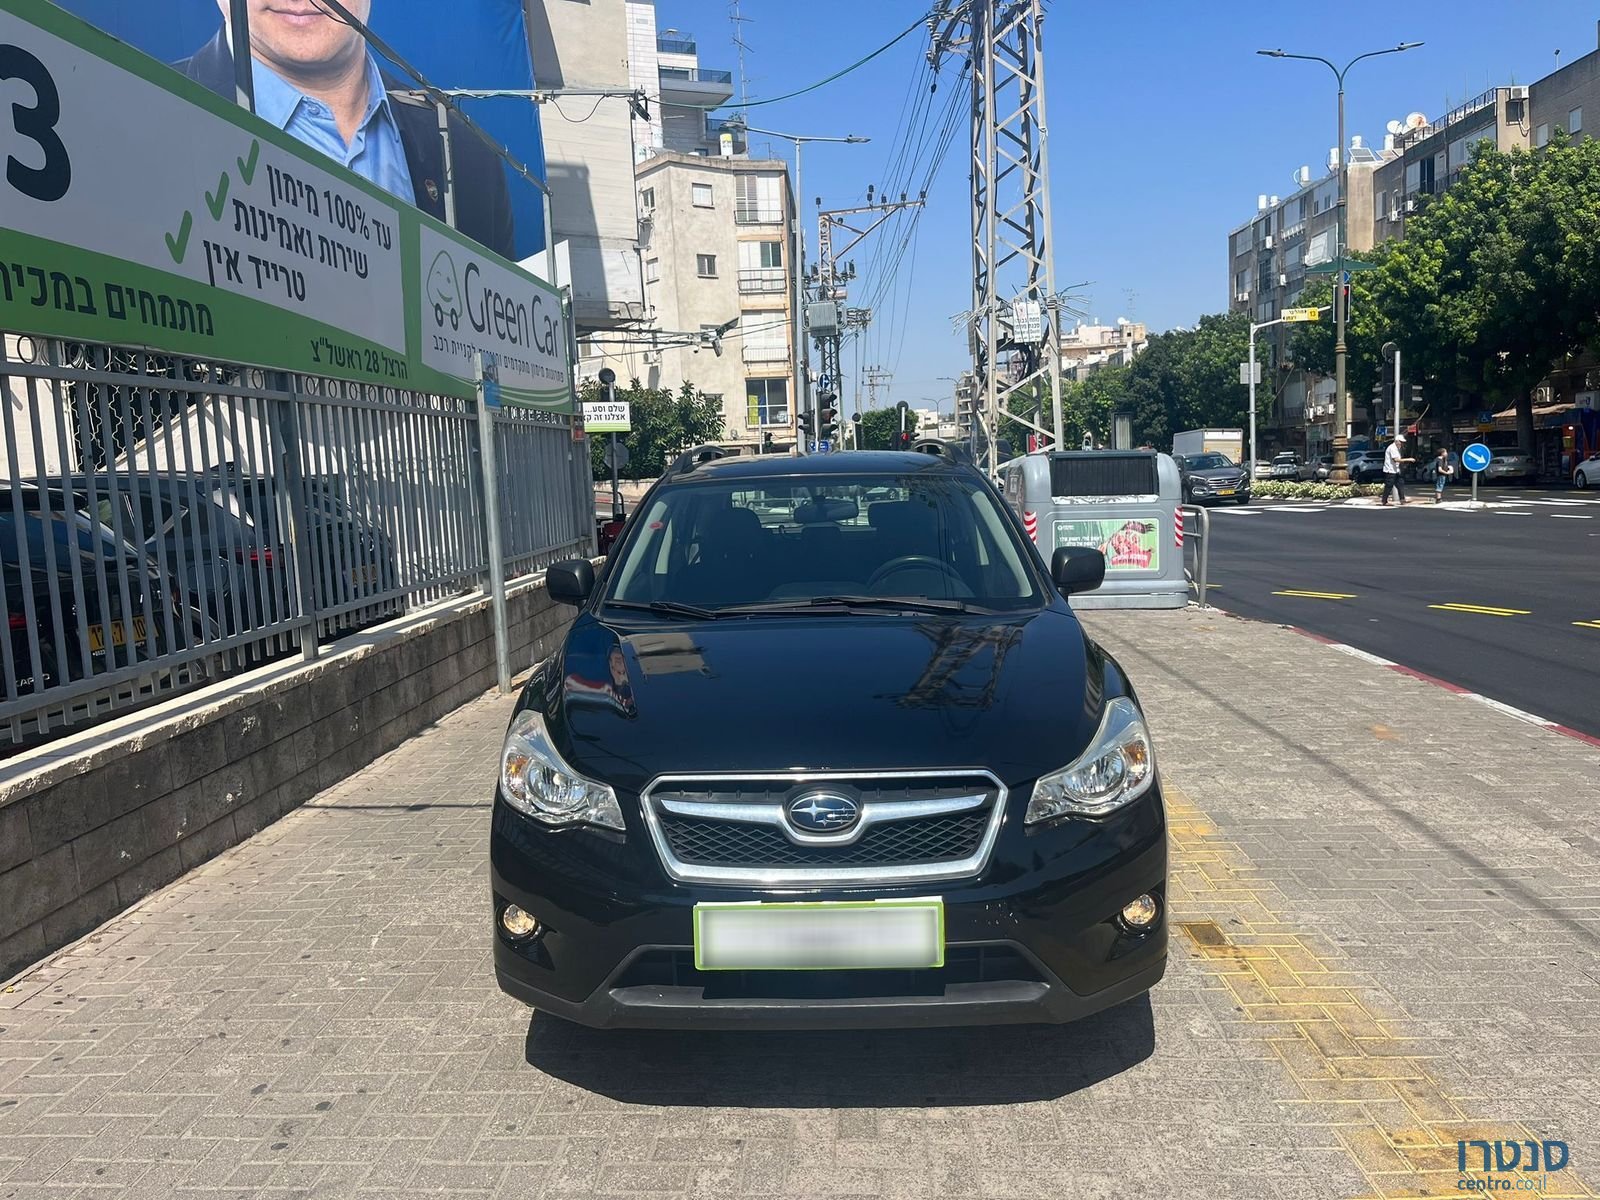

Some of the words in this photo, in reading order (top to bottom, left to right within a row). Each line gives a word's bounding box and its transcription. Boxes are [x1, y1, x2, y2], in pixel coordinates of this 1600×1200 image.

[266, 164, 320, 217] מימון
[232, 198, 314, 259] ואמינות
[324, 190, 370, 241] 100%
[372, 218, 392, 251] עד
[203, 240, 243, 287] אין
[248, 254, 306, 301] טרייד
[318, 234, 369, 279] שירות
[104, 282, 214, 336] מתמחים
[465, 262, 529, 348] Green
[532, 294, 559, 358] Car
[364, 349, 380, 374] 28
[381, 351, 408, 379] הרצל
[433, 335, 449, 353] רכב
[605, 413, 626, 421] אצלנו
[608, 404, 625, 413] שלם
